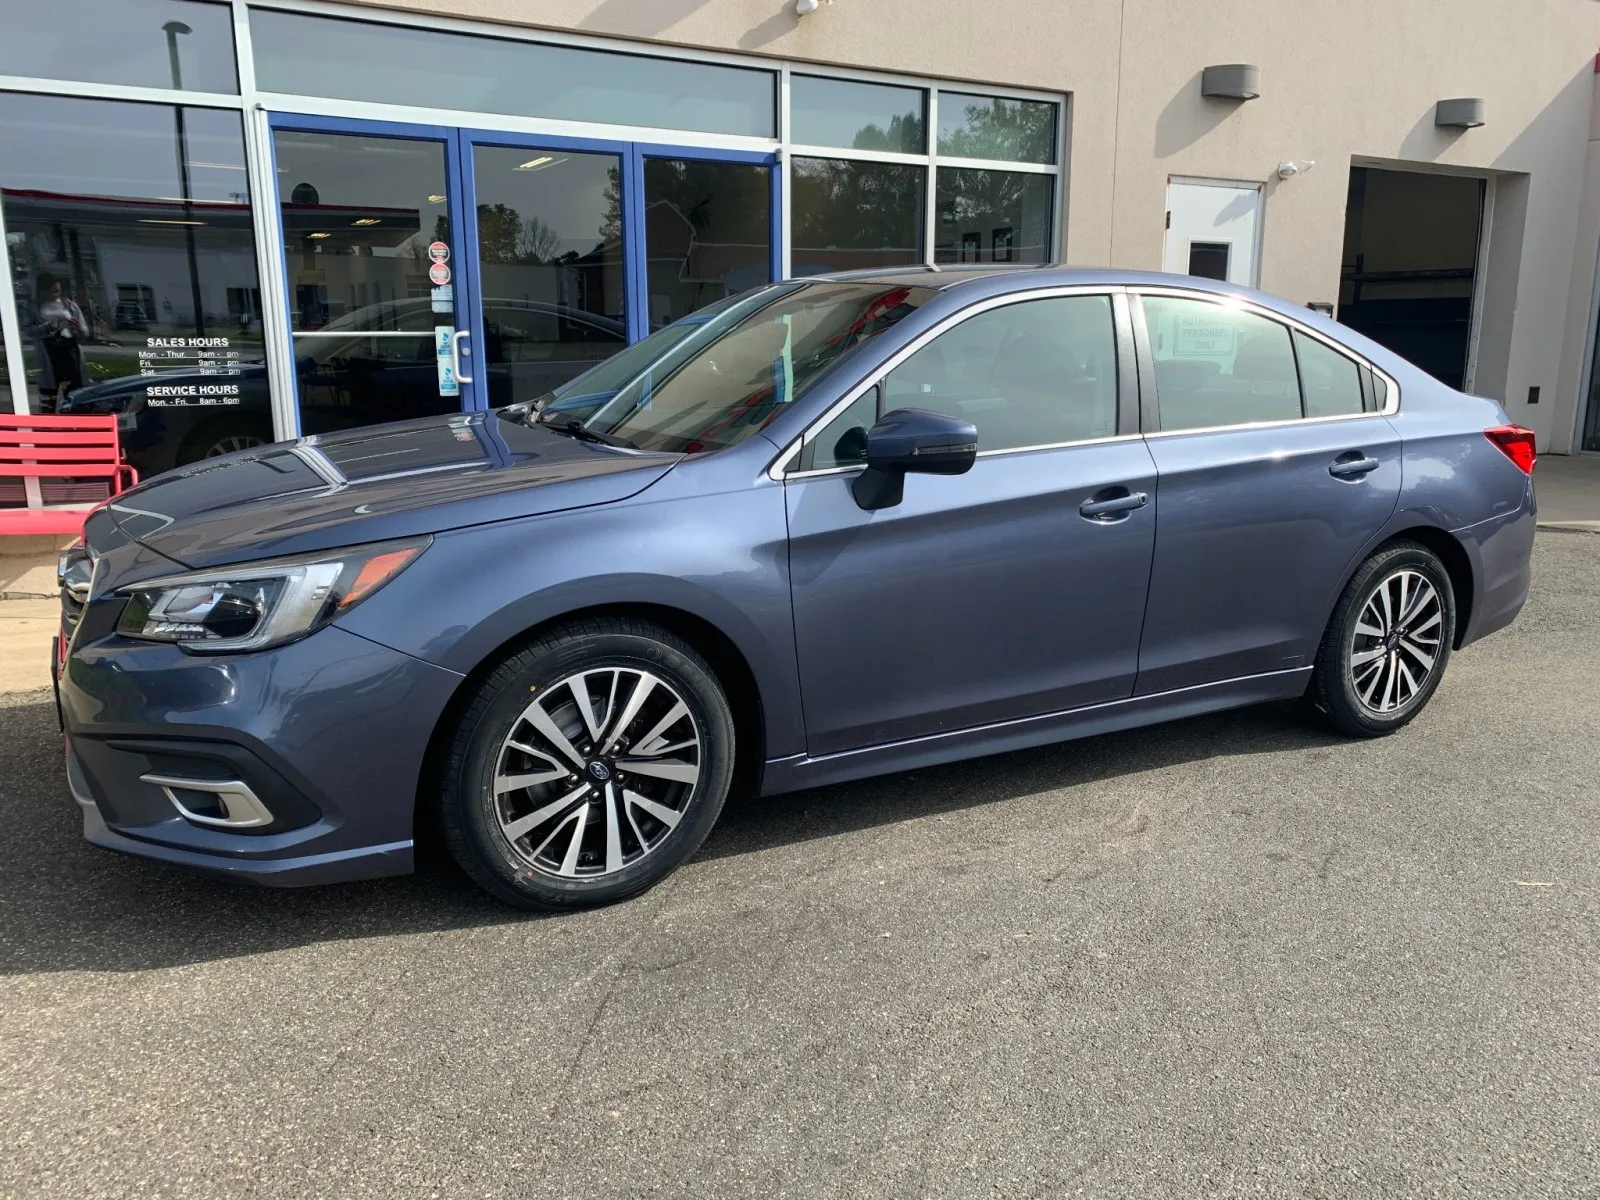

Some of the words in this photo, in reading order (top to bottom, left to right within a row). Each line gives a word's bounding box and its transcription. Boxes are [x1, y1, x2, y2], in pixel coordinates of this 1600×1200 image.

[1183, 328, 1229, 337] PERSONNEL
[147, 338, 185, 346] SALES
[188, 337, 229, 346] HOURS
[1195, 340, 1216, 349] ONLY
[146, 386, 196, 395] SERVICE
[199, 385, 239, 394] HOURS
[223, 397, 240, 405] 6pm
